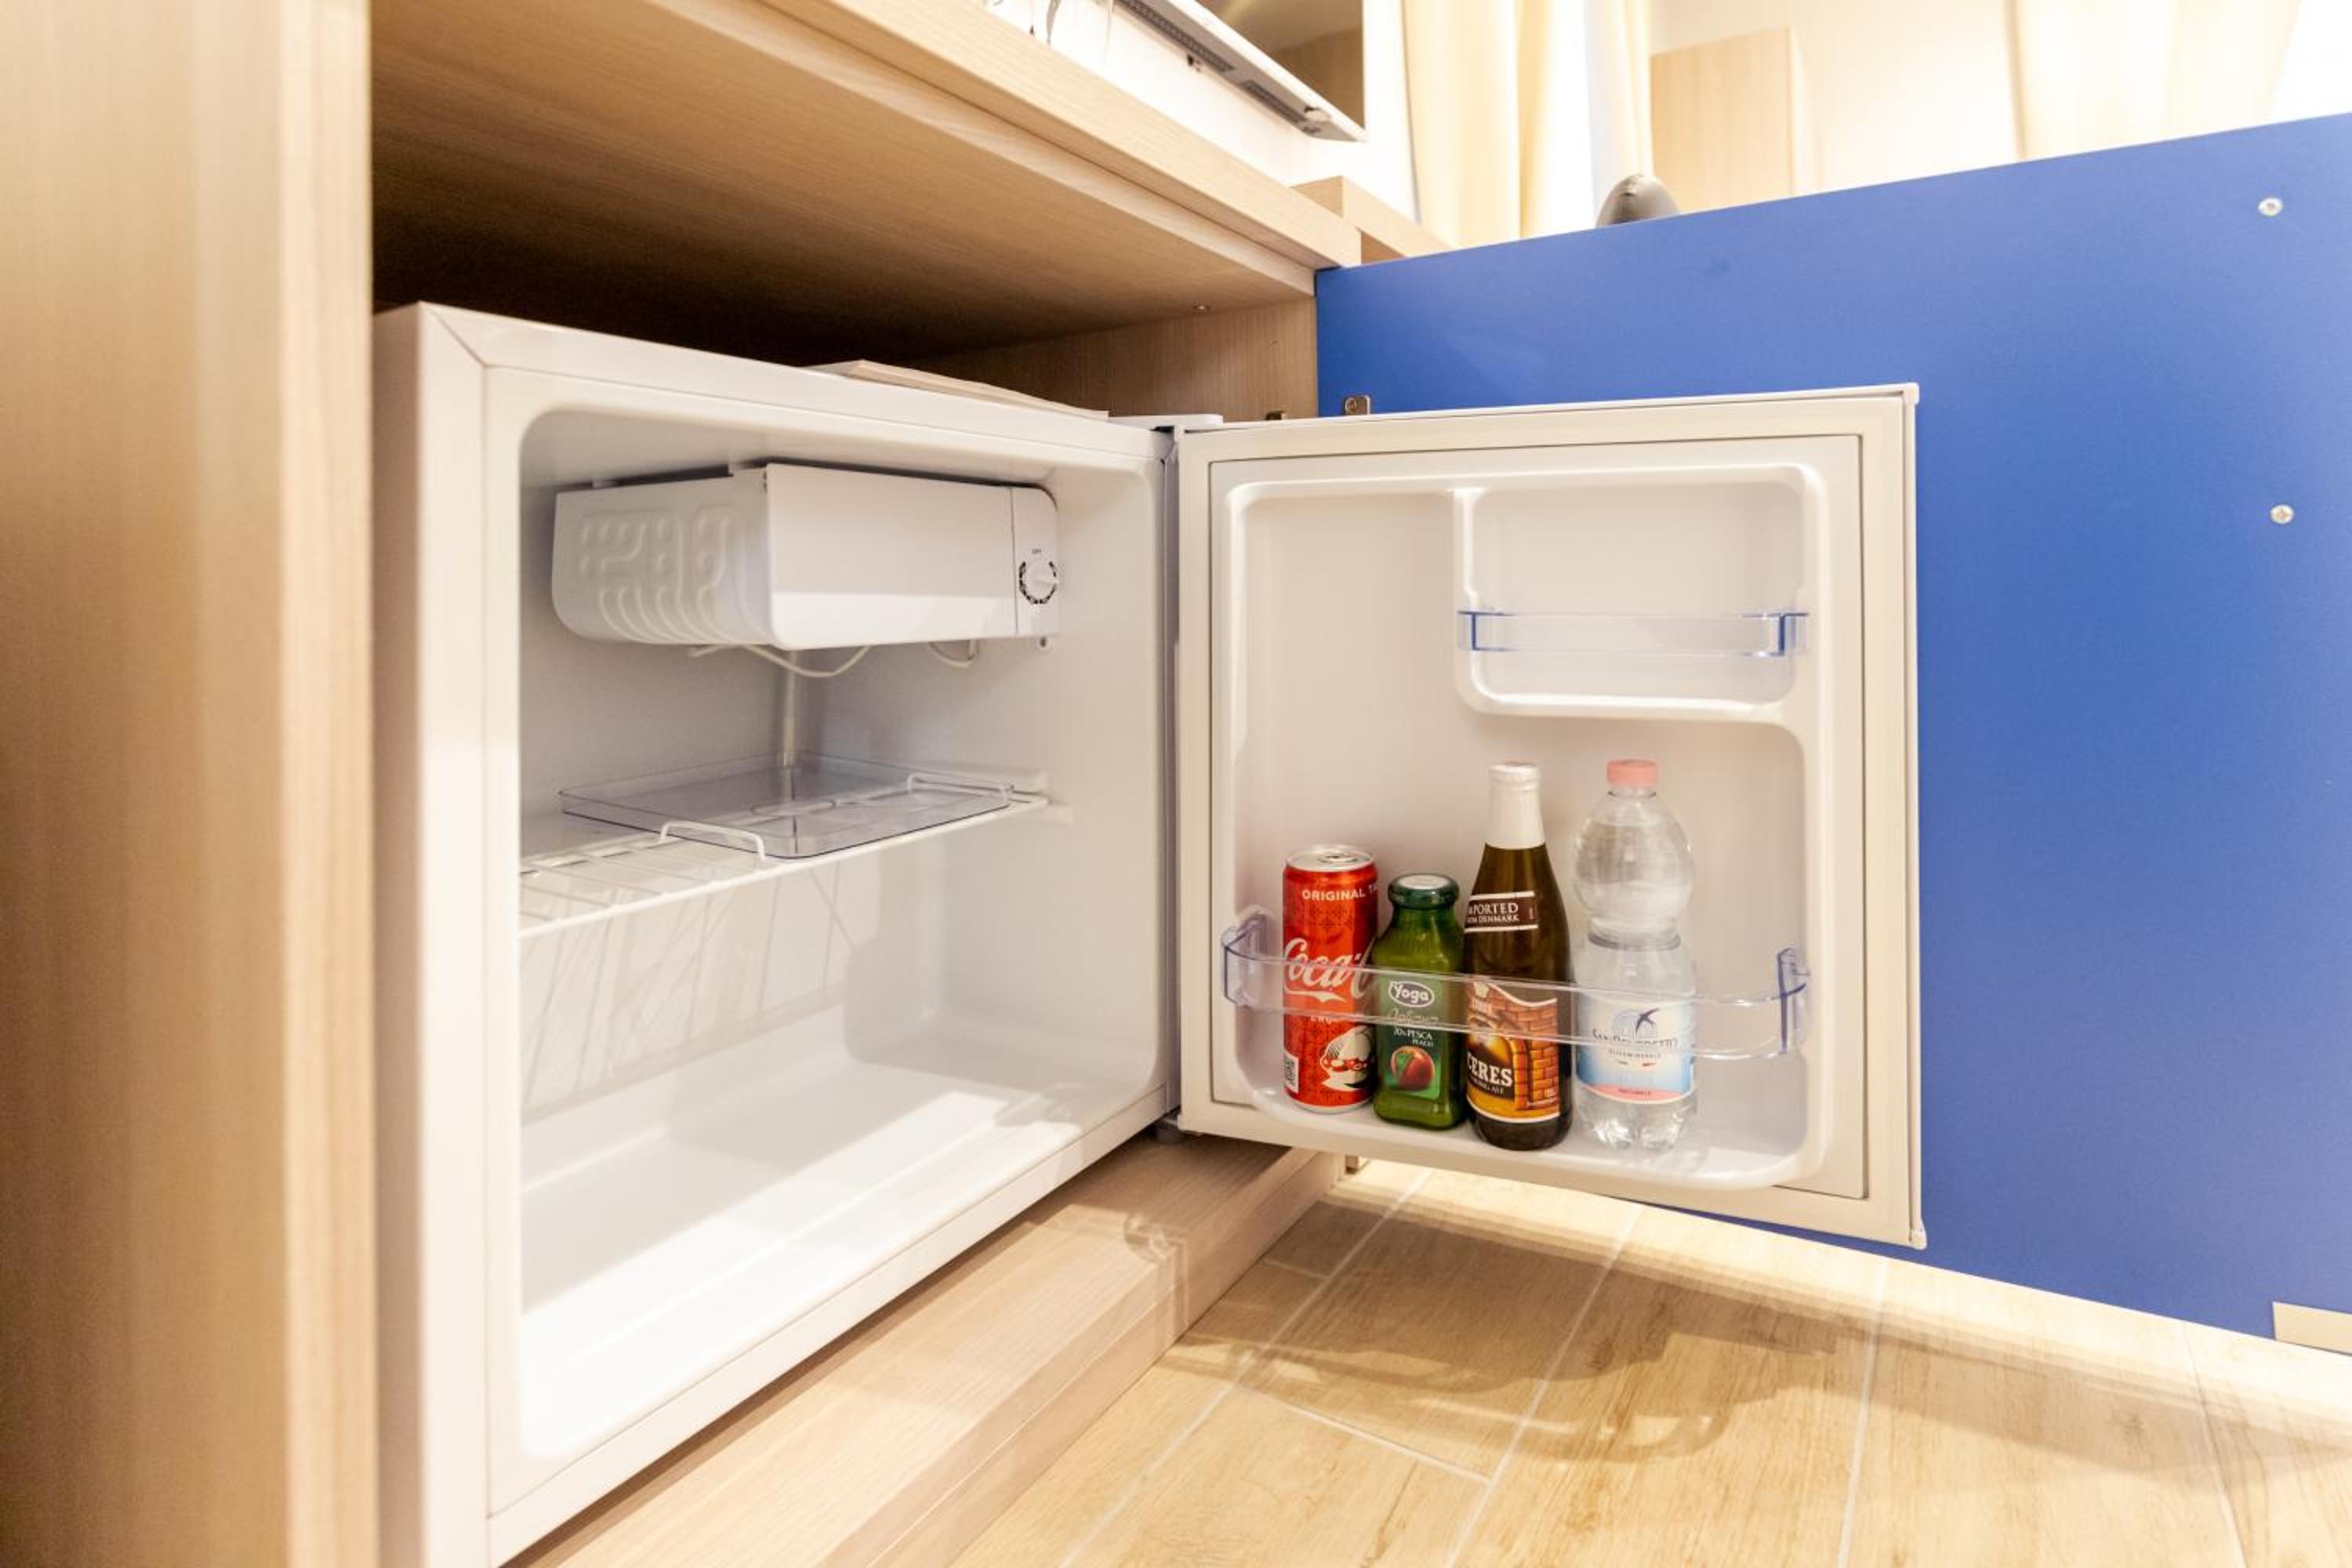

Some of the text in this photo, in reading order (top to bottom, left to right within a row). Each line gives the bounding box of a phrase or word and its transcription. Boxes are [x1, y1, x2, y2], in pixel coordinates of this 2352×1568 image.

[1302, 887, 1366, 901] ORIGINAL
[1478, 914, 1519, 924] DENMARK
[1391, 983, 1430, 1004] Yoga
[1407, 1029, 1433, 1041] PESCA
[1468, 1051, 1513, 1087] CERES
